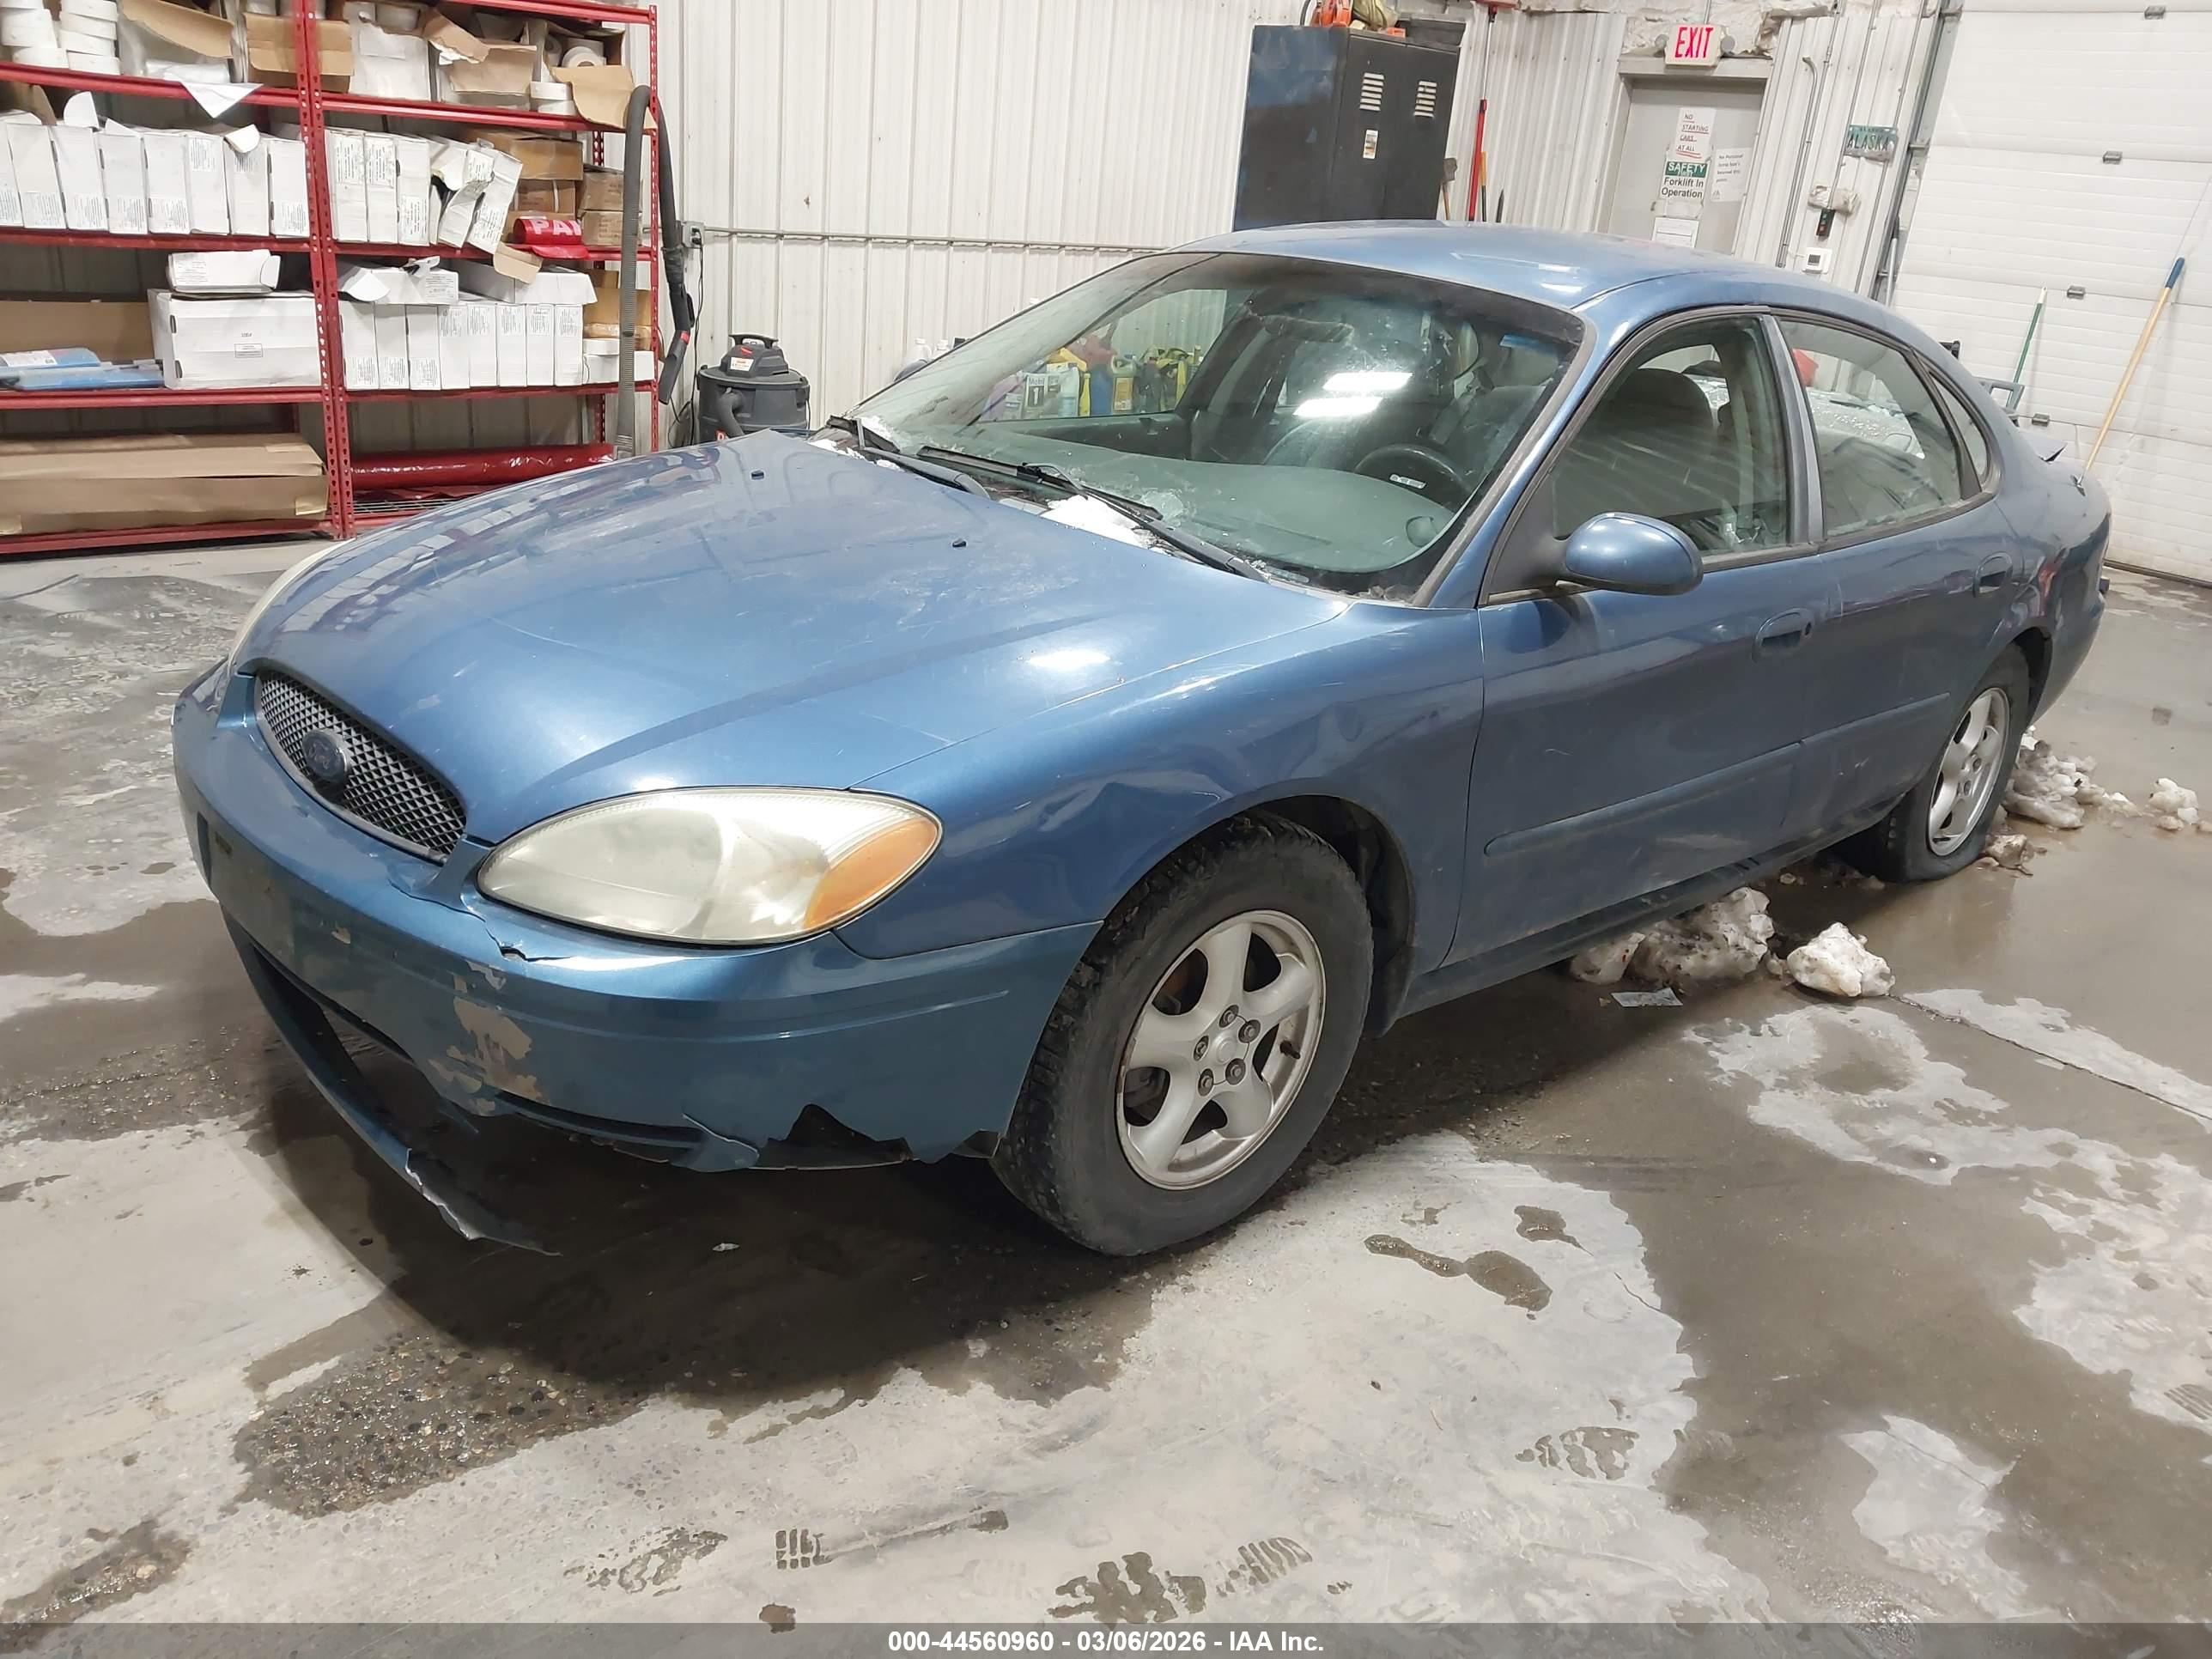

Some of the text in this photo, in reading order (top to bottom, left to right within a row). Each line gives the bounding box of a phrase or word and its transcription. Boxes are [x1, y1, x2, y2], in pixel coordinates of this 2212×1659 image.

[1674, 27, 1714, 58] EXIT
[1682, 124, 1709, 132] STARTING
[1847, 134, 1889, 151] ALASKA
[1668, 161, 1705, 173] SAFETY
[1663, 177, 1704, 187] Forklift In
[1662, 187, 1703, 198] Operation
